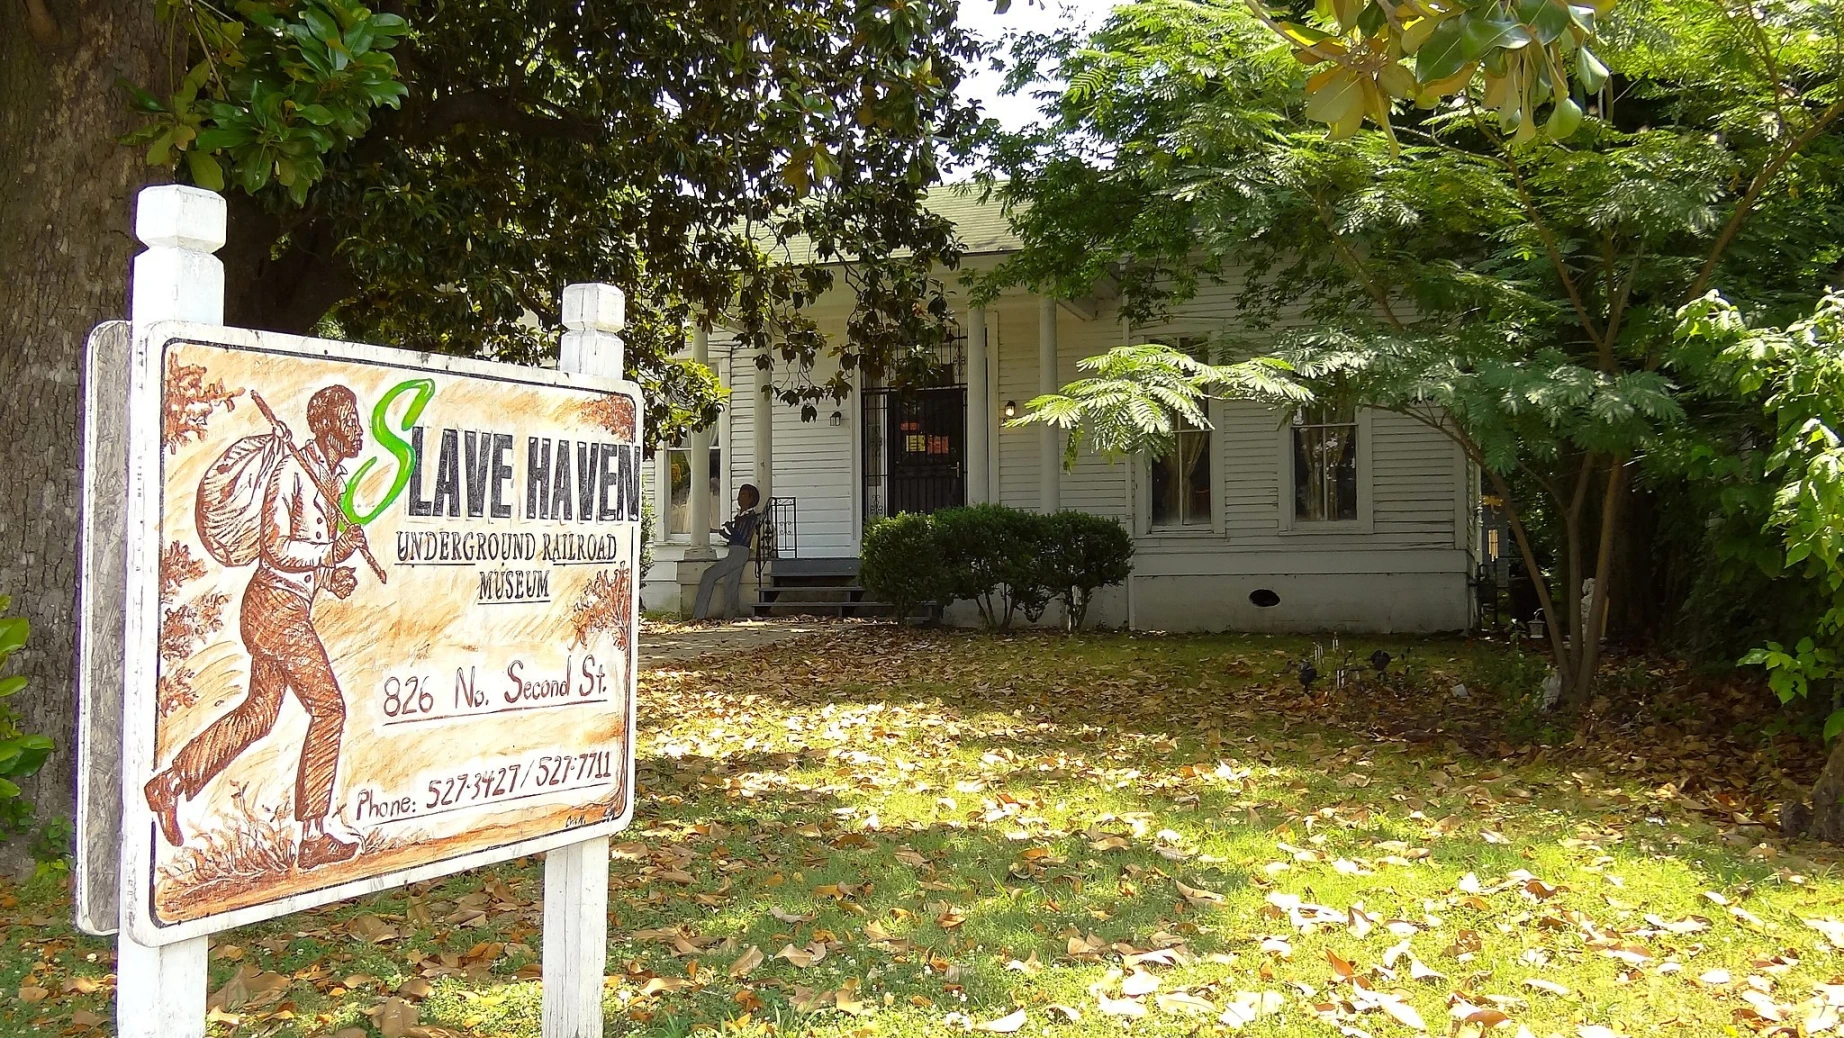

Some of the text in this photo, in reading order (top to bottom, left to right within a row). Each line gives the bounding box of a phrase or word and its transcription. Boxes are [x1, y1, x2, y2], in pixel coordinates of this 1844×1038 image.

[526, 436, 640, 521] HAVEN
[396, 531, 617, 562] UNDERGROUND RAILROAD
[478, 570, 550, 600] MUSEUM
[383, 654, 607, 717] 826 No. Second St.
[356, 789, 416, 821] Phone:
